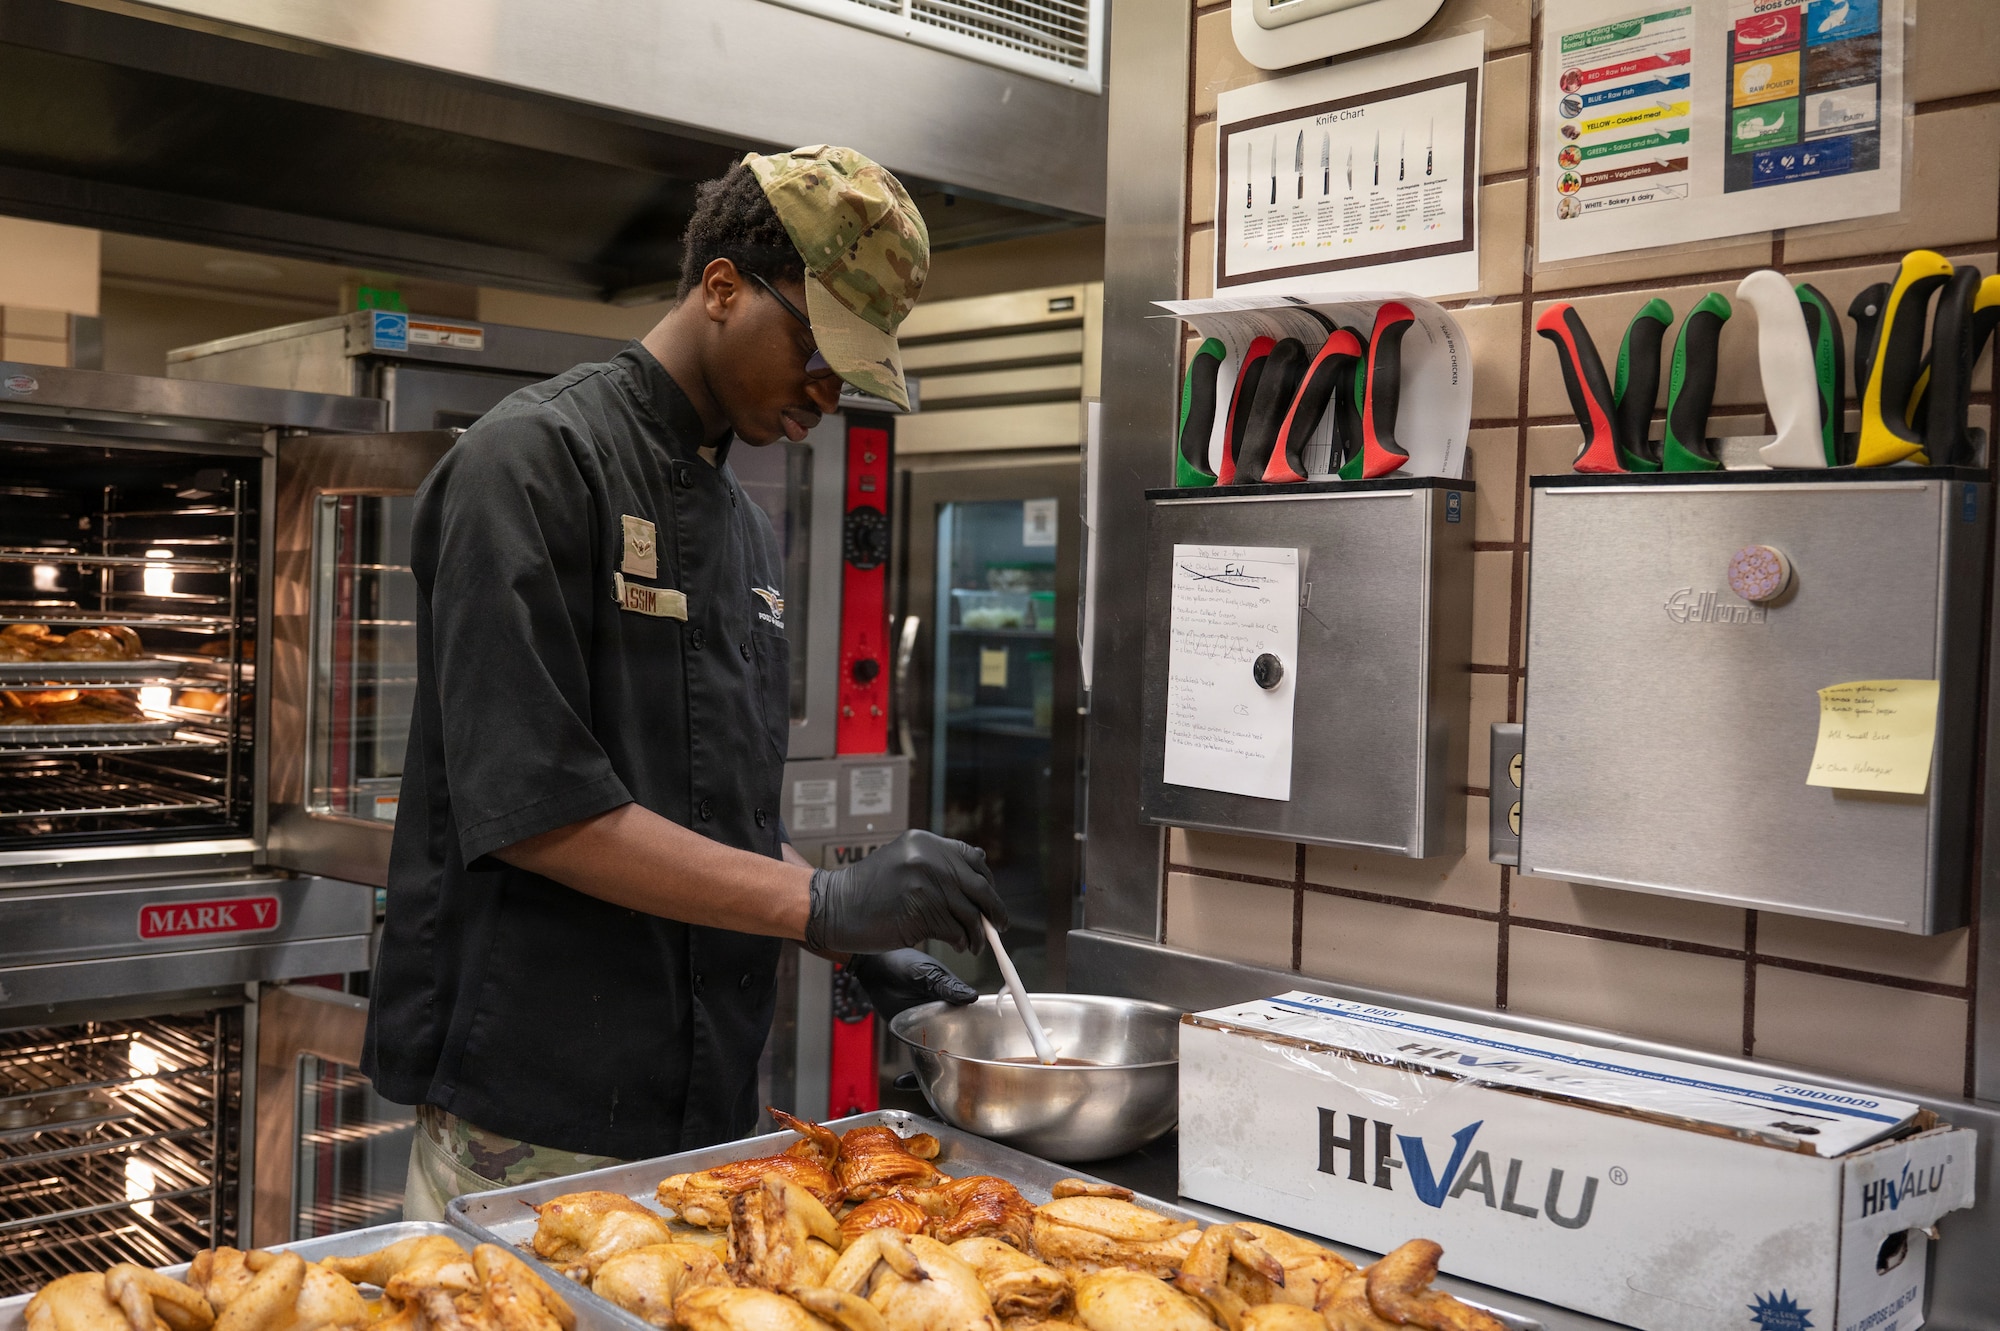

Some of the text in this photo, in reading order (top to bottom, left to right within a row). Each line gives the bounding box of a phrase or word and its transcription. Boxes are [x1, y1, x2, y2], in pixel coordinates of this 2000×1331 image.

[1754, 2, 1782, 13] CROSS
[1563, 18, 1645, 42] Colour Coding Chopping
[1563, 40, 1585, 50] Boards
[1592, 33, 1614, 44] Knives
[1761, 37, 1776, 45] RAW
[1588, 72, 1600, 80] RED
[1605, 67, 1619, 76] Raw
[1620, 64, 1637, 73] Meat
[1749, 79, 1795, 93] RAW POULTRY
[1588, 94, 1602, 104] BLUE
[1608, 90, 1622, 99] Raw
[1622, 88, 1635, 97] Fish
[1316, 108, 1365, 126] Knife Chart
[1587, 120, 1610, 130] YELLOW
[1616, 113, 1642, 124] Cooked
[1643, 110, 1662, 119] meat
[1843, 112, 1865, 122] DAIRY
[1759, 126, 1793, 137] PRODUCE
[1587, 146, 1608, 156] GREEN
[1613, 141, 1632, 151] Salad
[1632, 139, 1645, 148] and
[1646, 137, 1660, 146] fruit
[1585, 174, 1609, 184] BROWN
[1614, 166, 1652, 179] Vegetables
[1585, 201, 1602, 210] WHITE
[1608, 196, 1631, 207] Bakery
[1637, 193, 1655, 202] dairy
[1447, 340, 1456, 354] BBQ
[148, 902, 272, 934] MARK V
[1346, 1013, 1402, 1027] WARNING!
[1403, 1024, 1426, 1033] Sharp
[1426, 1029, 1453, 1039] Cutter
[1477, 1040, 1494, 1048] Use
[1495, 1043, 1517, 1052] With
[1554, 1055, 1577, 1065] Keep
[1609, 1066, 1637, 1075] Waist
[1638, 1071, 1664, 1081] Level
[1664, 1076, 1694, 1086] When
[1695, 1081, 1748, 1097] Dispensing
[1773, 1083, 1880, 1109] 73000009
[1316, 1106, 1600, 1230] HI-VALU
[1862, 1158, 1945, 1218] HI-VALU
[1859, 1305, 1889, 1331] PURPOSE
[1888, 1294, 1906, 1318] CLING
[1905, 1285, 1918, 1306] FILM
